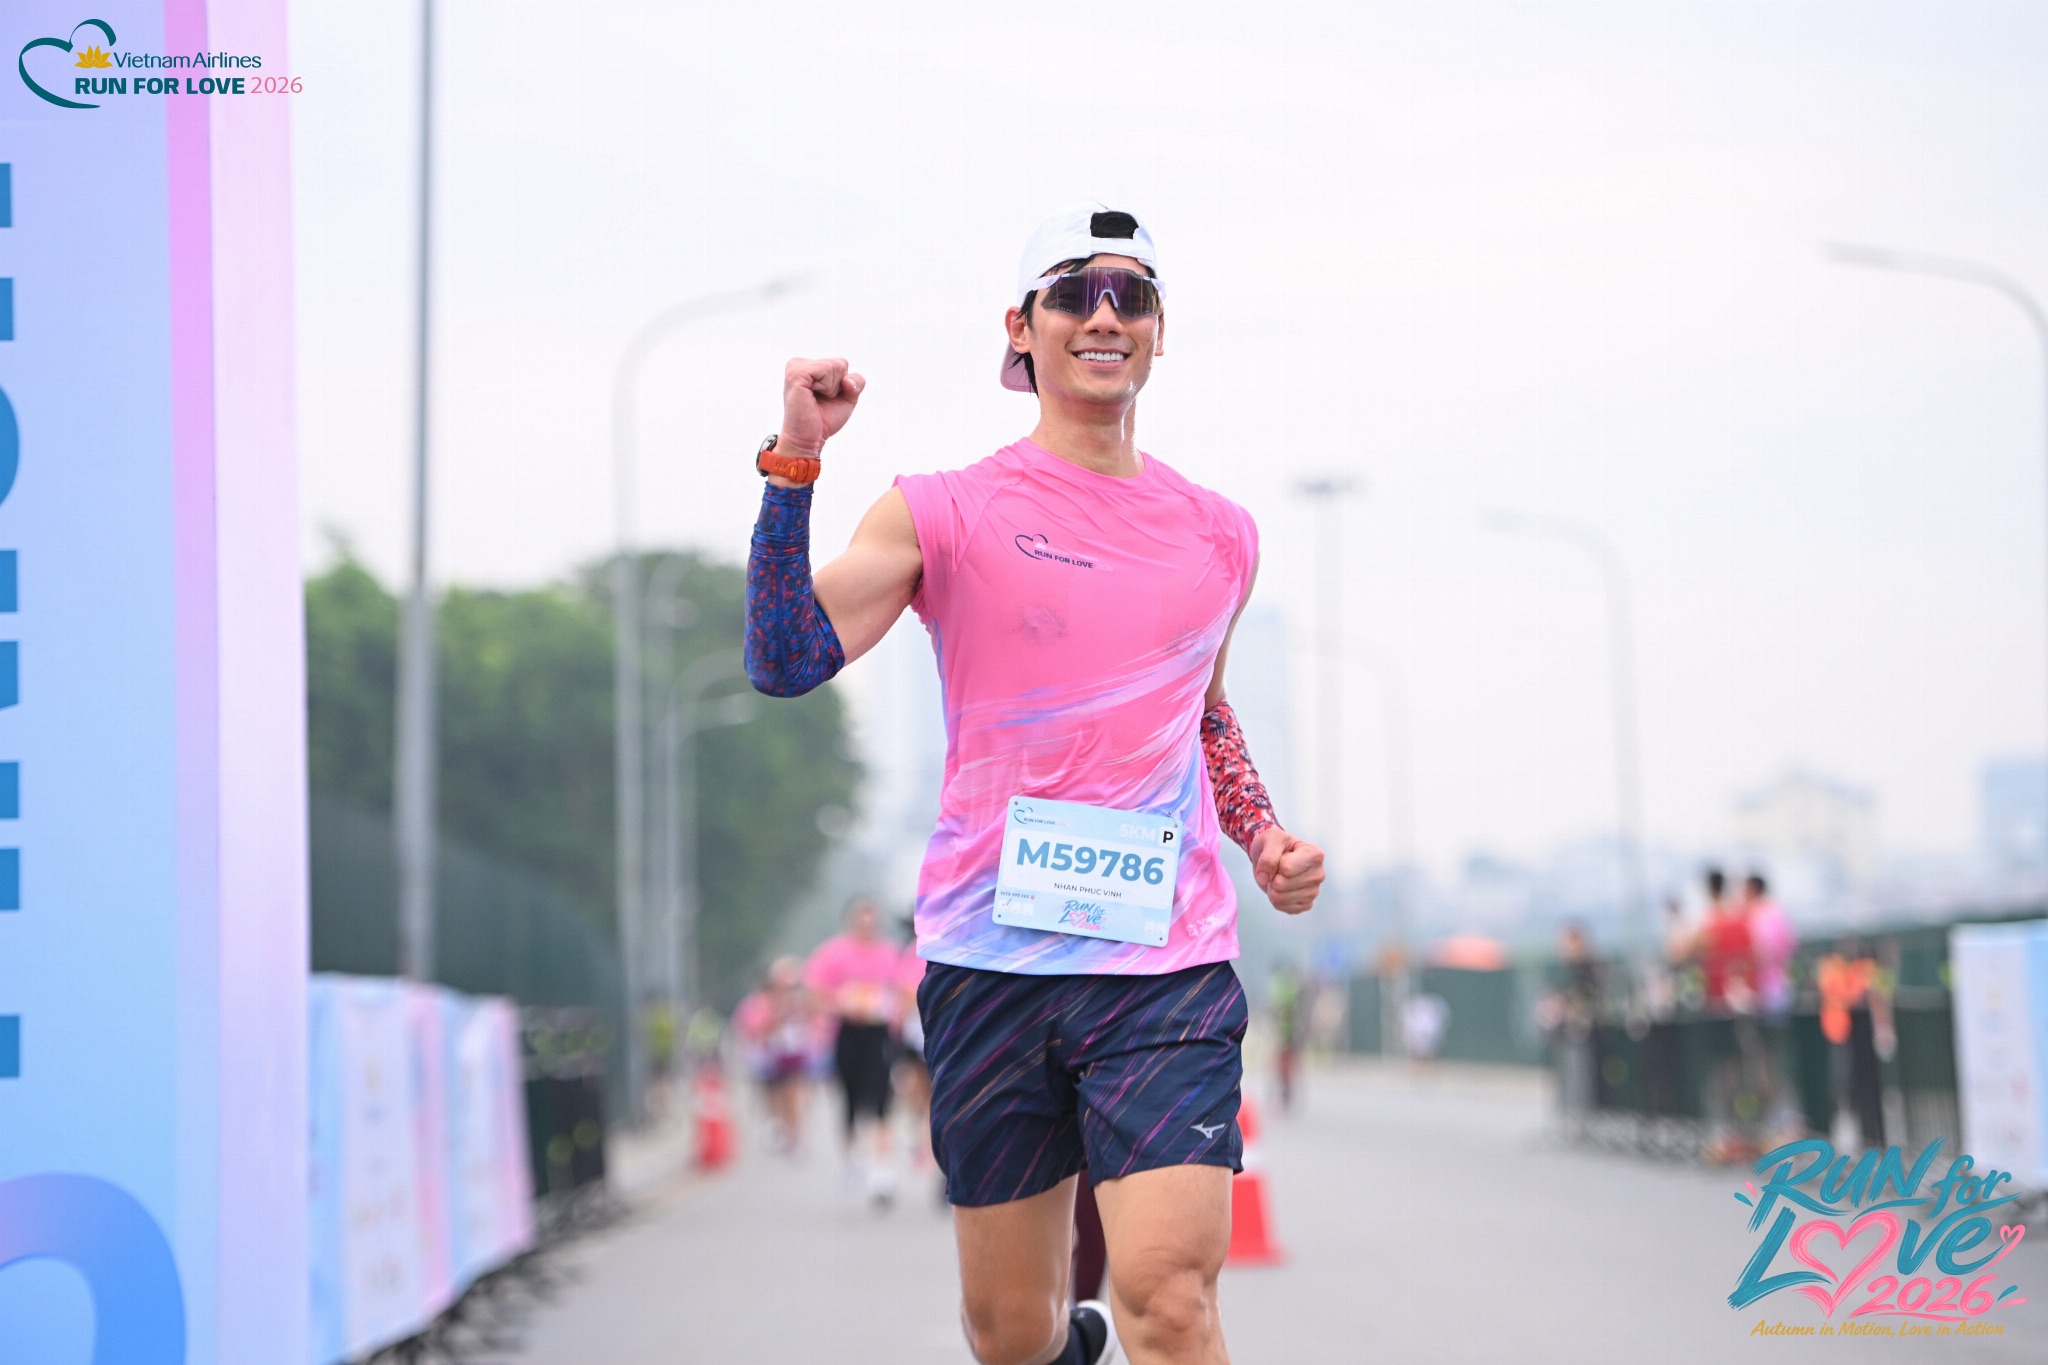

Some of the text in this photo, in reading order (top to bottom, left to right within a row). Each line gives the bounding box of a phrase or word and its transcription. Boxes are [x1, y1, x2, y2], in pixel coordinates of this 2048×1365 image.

[1034, 549, 1053, 560] RUN
[1054, 554, 1071, 564] FOR
[1071, 559, 1093, 569] LOVE
[1119, 823, 1156, 842] 5KM
[1162, 830, 1174, 843] P
[1016, 838, 1165, 885] M59786
[1053, 882, 1122, 899] NHAN PHUC VINH
[1063, 900, 1097, 912] RUN
